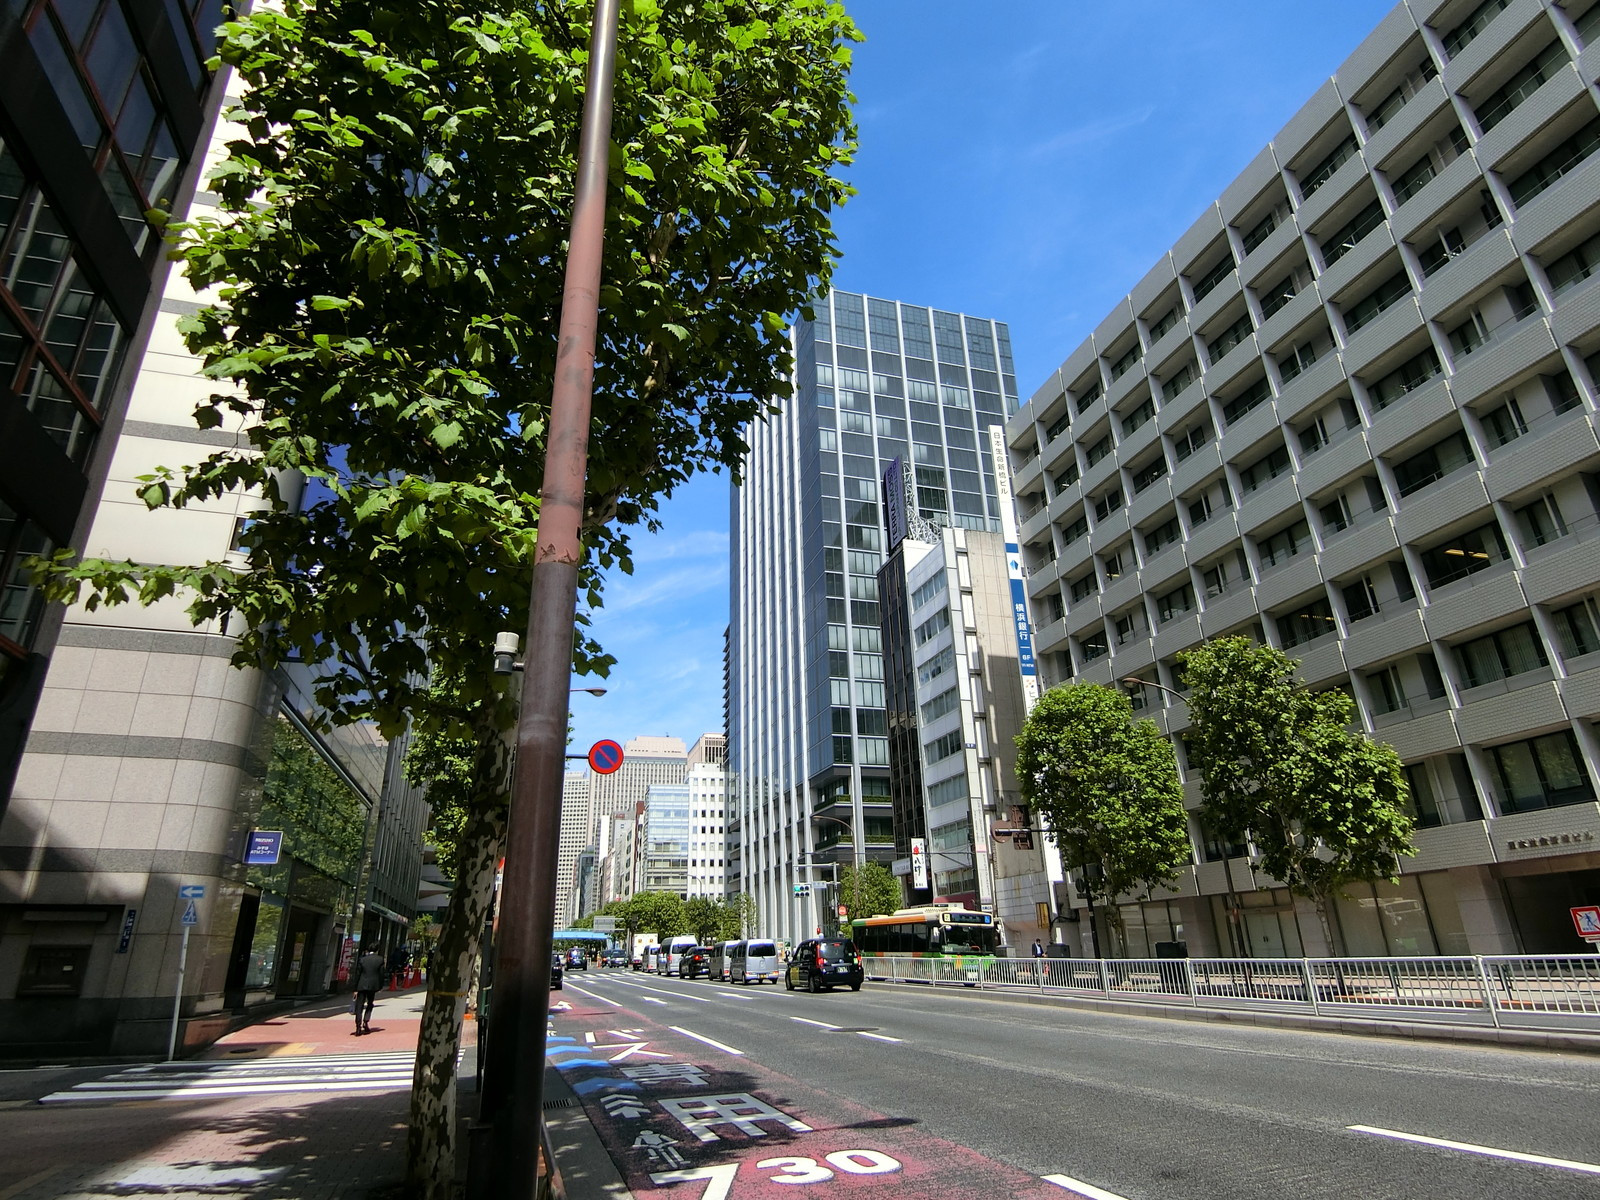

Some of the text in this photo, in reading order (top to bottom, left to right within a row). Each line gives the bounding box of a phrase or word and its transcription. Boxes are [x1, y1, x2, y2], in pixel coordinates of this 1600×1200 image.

[890, 503, 898, 544] TERRA
[1015, 603, 1029, 641] 横浜銀行
